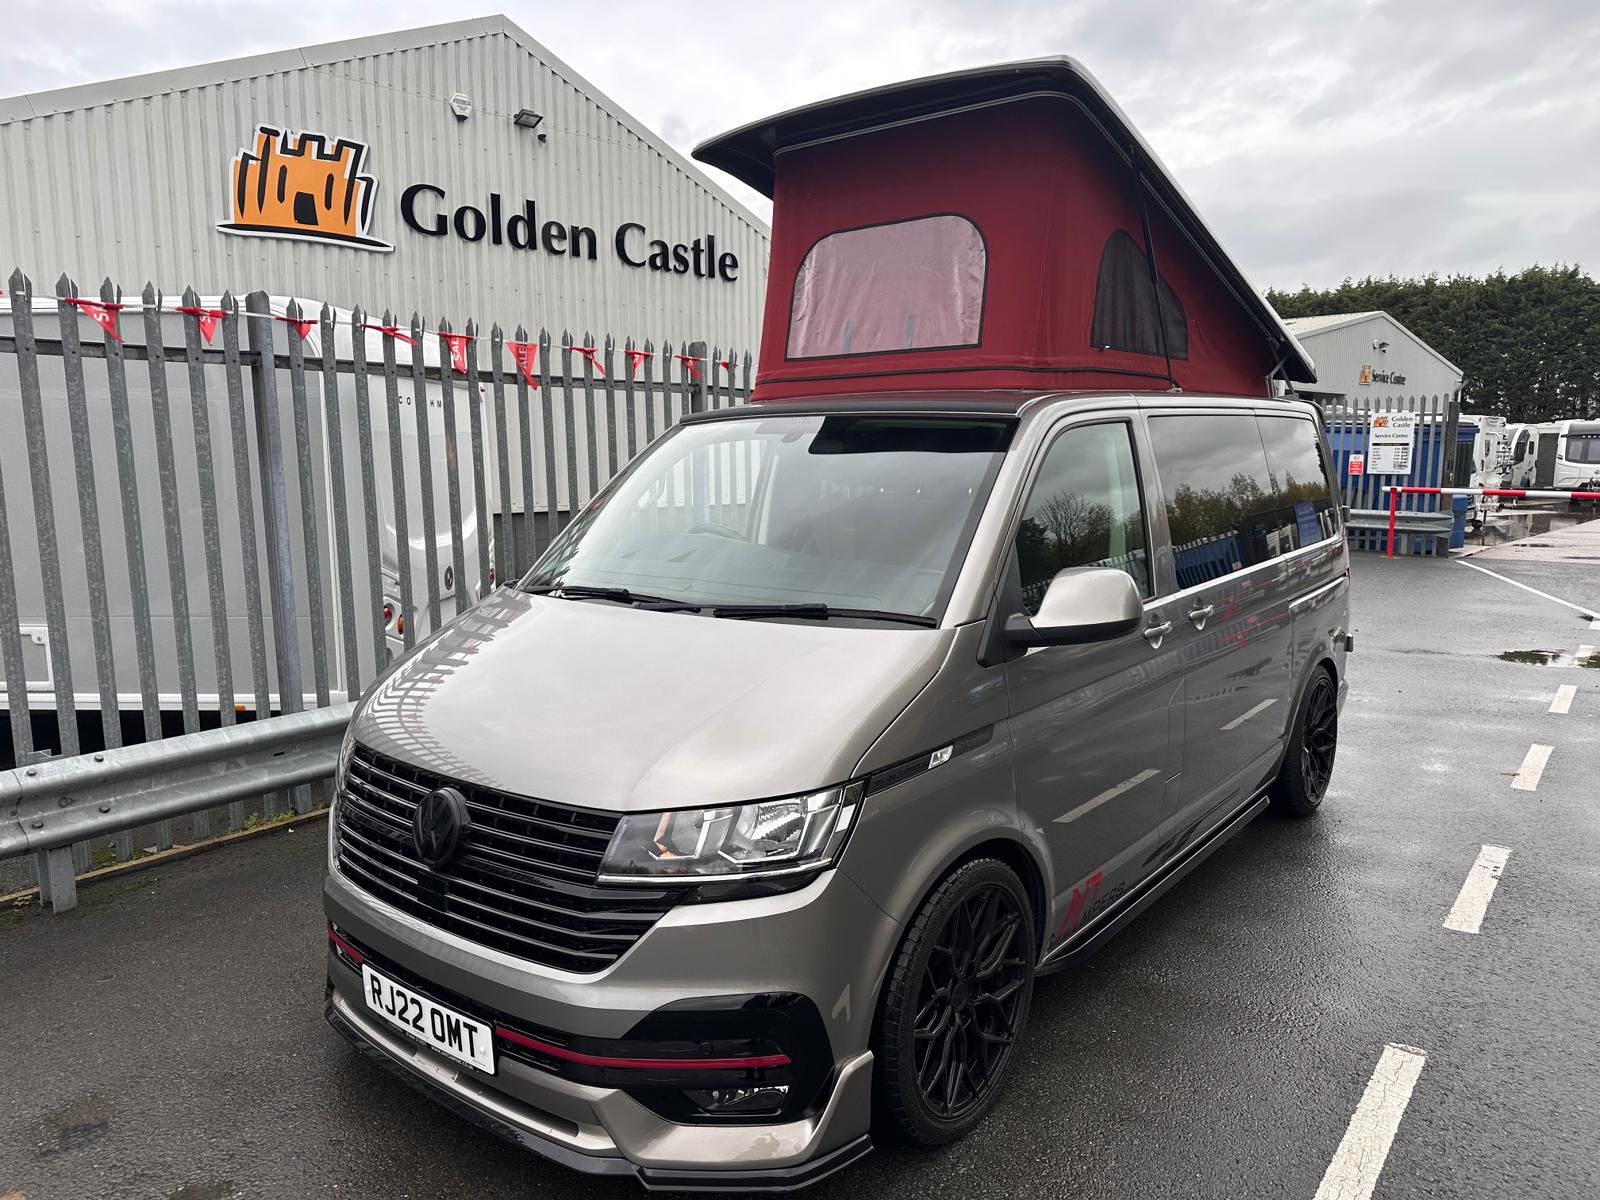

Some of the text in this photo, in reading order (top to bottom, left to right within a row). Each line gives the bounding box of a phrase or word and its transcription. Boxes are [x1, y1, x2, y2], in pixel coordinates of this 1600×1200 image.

[400, 183, 739, 283] Golden Castle
[1371, 370, 1407, 386] Service Centre
[370, 973, 478, 1058] RJ22 OMT
